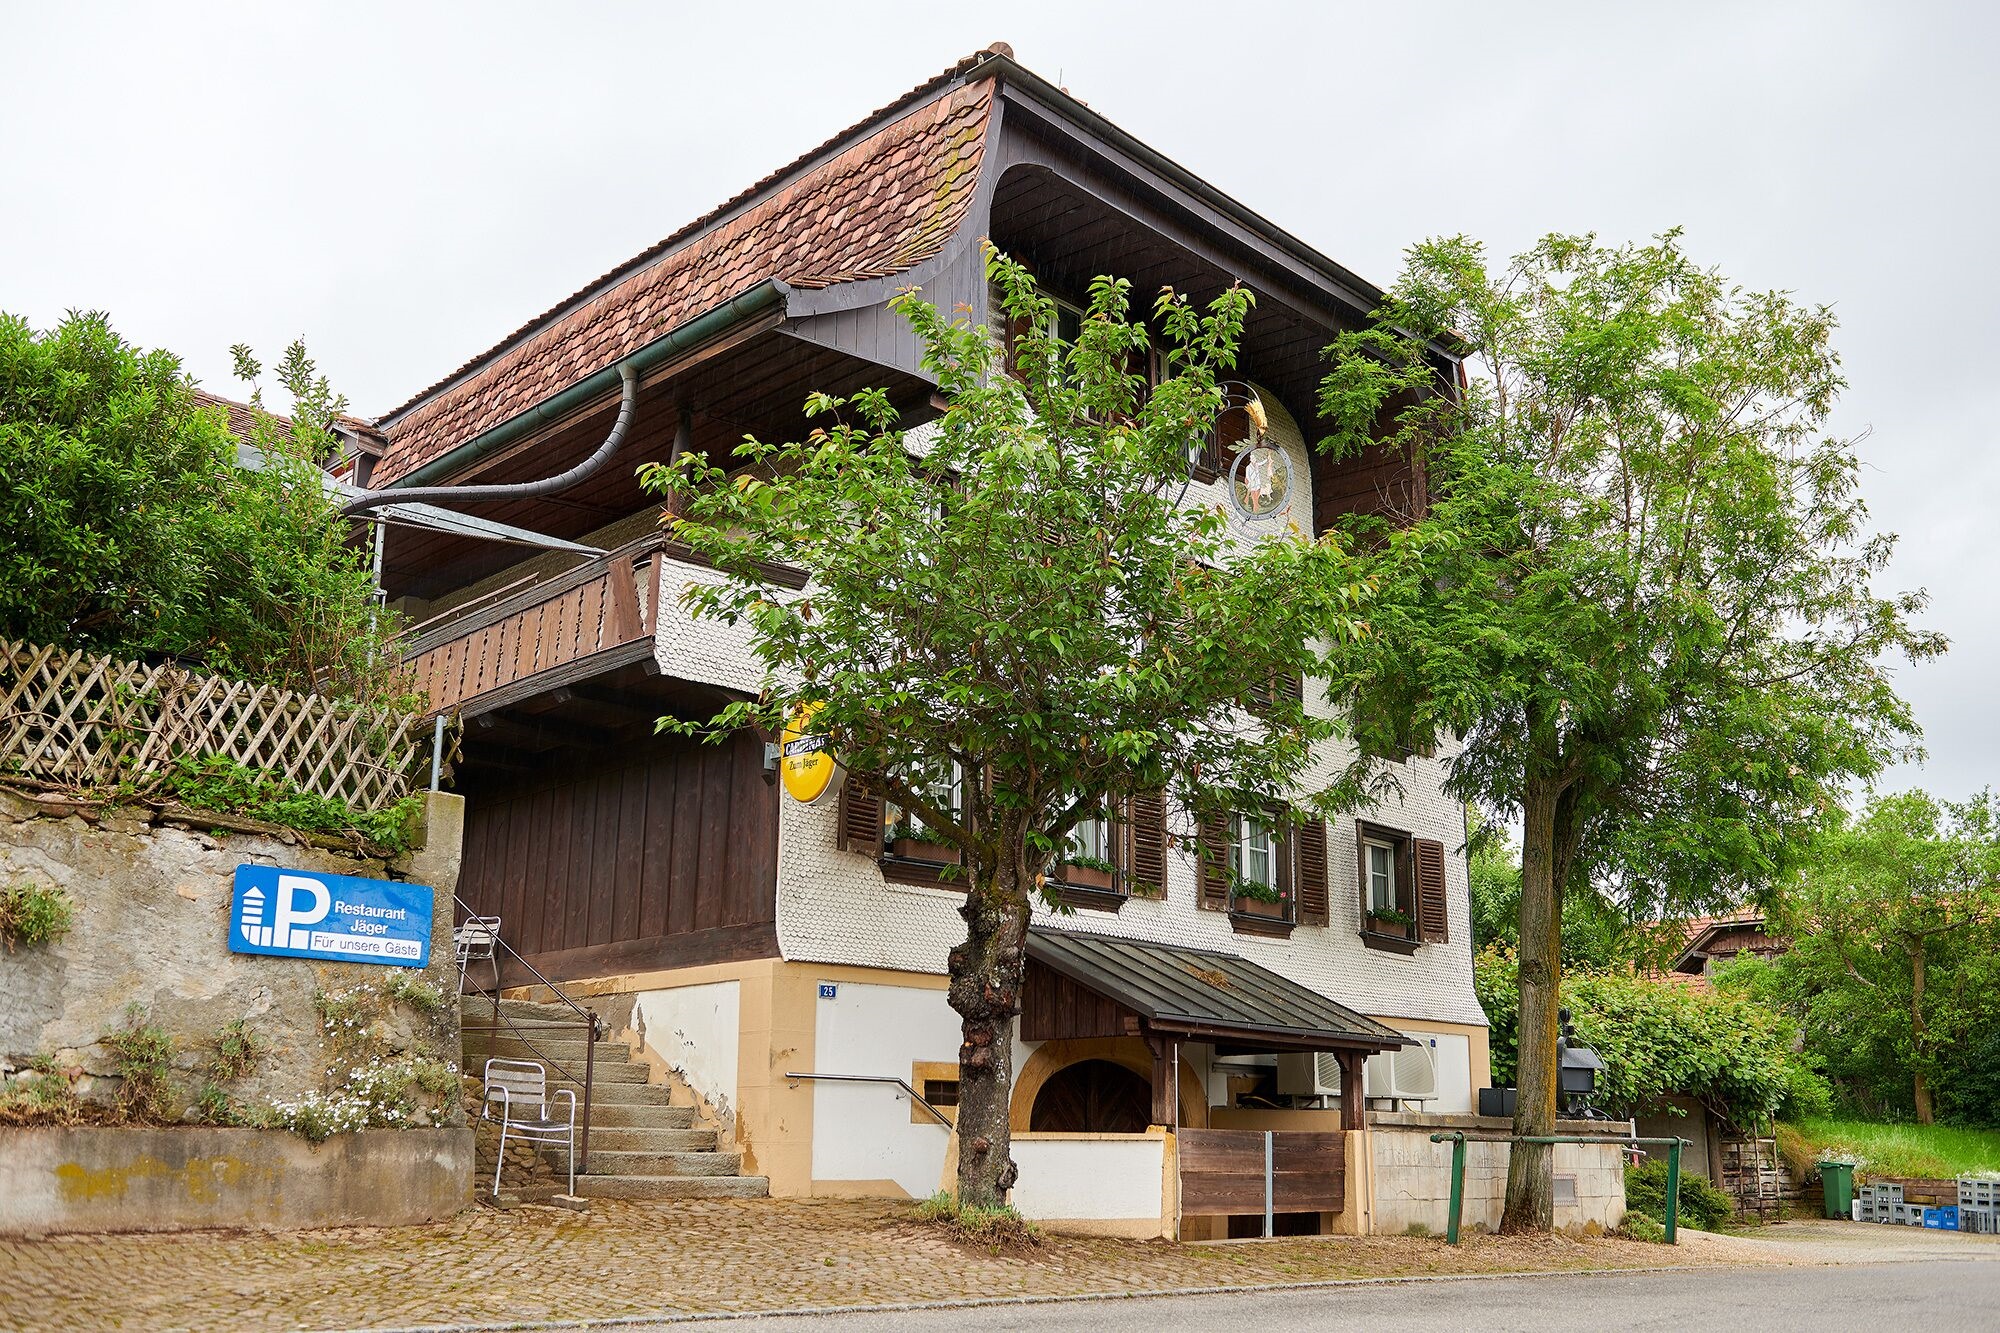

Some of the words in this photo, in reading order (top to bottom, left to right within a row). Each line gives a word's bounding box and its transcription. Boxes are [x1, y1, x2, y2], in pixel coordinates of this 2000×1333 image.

[272, 874, 331, 949] P
[334, 900, 406, 921] Restaurant
[350, 919, 389, 936] Jäger
[314, 935, 335, 949] Für
[339, 940, 380, 953] unsere
[384, 941, 418, 957] Gäste
[824, 986, 833, 996] 25
